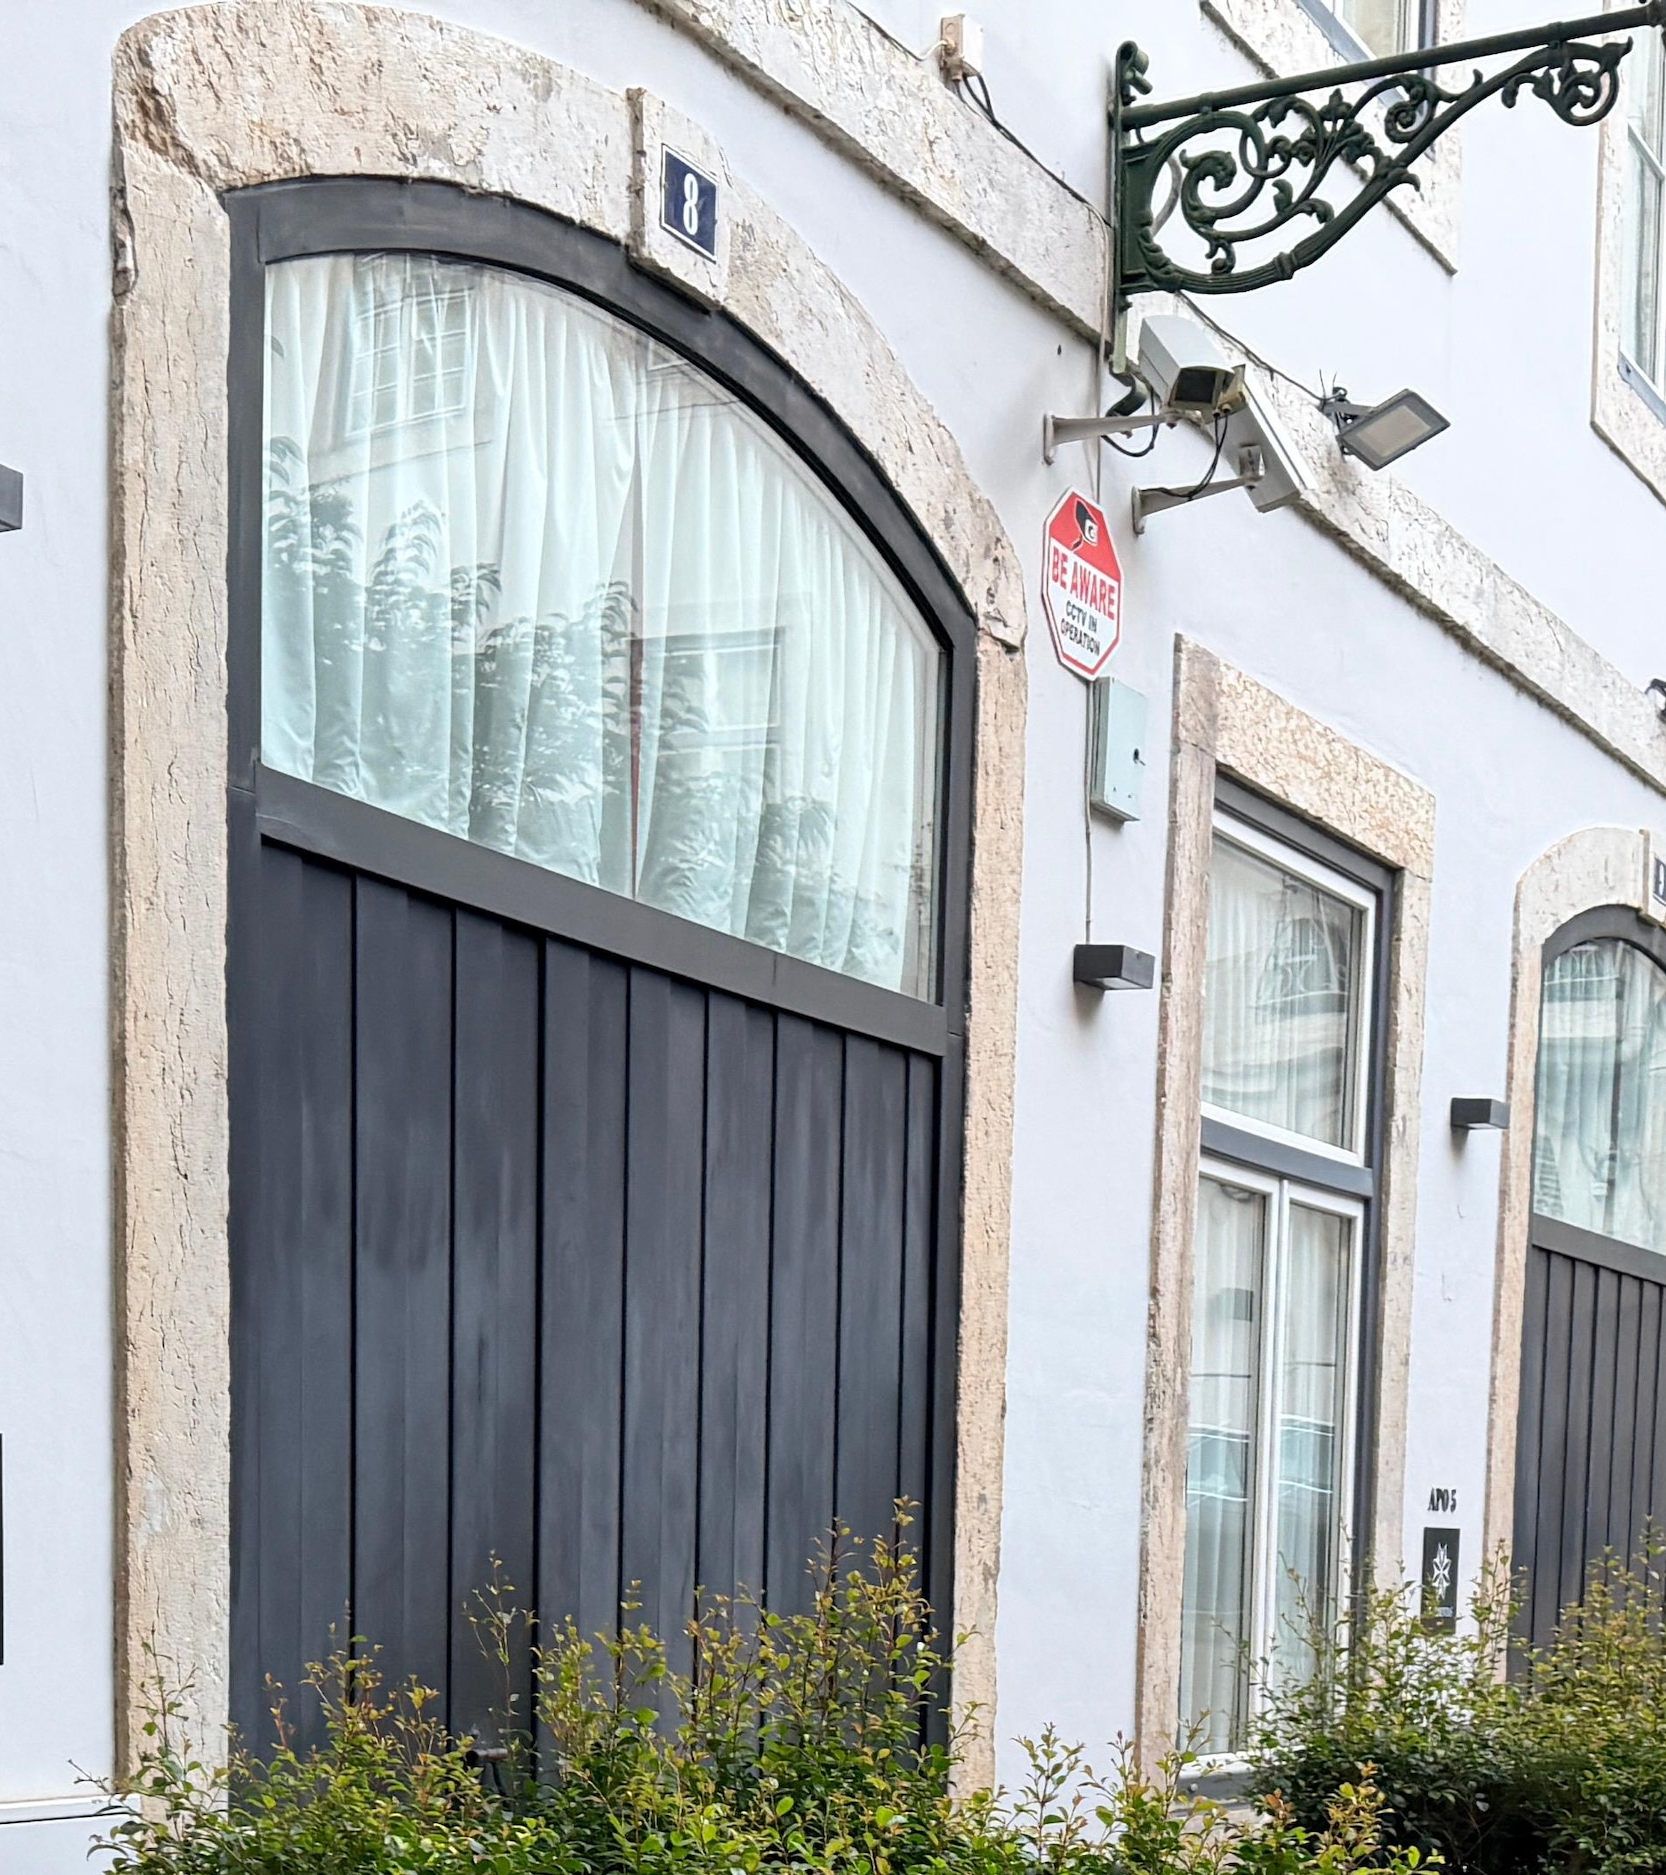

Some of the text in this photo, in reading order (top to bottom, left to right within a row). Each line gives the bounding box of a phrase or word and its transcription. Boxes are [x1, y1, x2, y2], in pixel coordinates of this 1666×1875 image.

[683, 172, 699, 235] 8
[1052, 545, 1116, 621] BE AWARE
[1066, 600, 1097, 632] CCTV IN
[1060, 617, 1101, 656] OPERATION
[1450, 1489, 1457, 1512] 5
